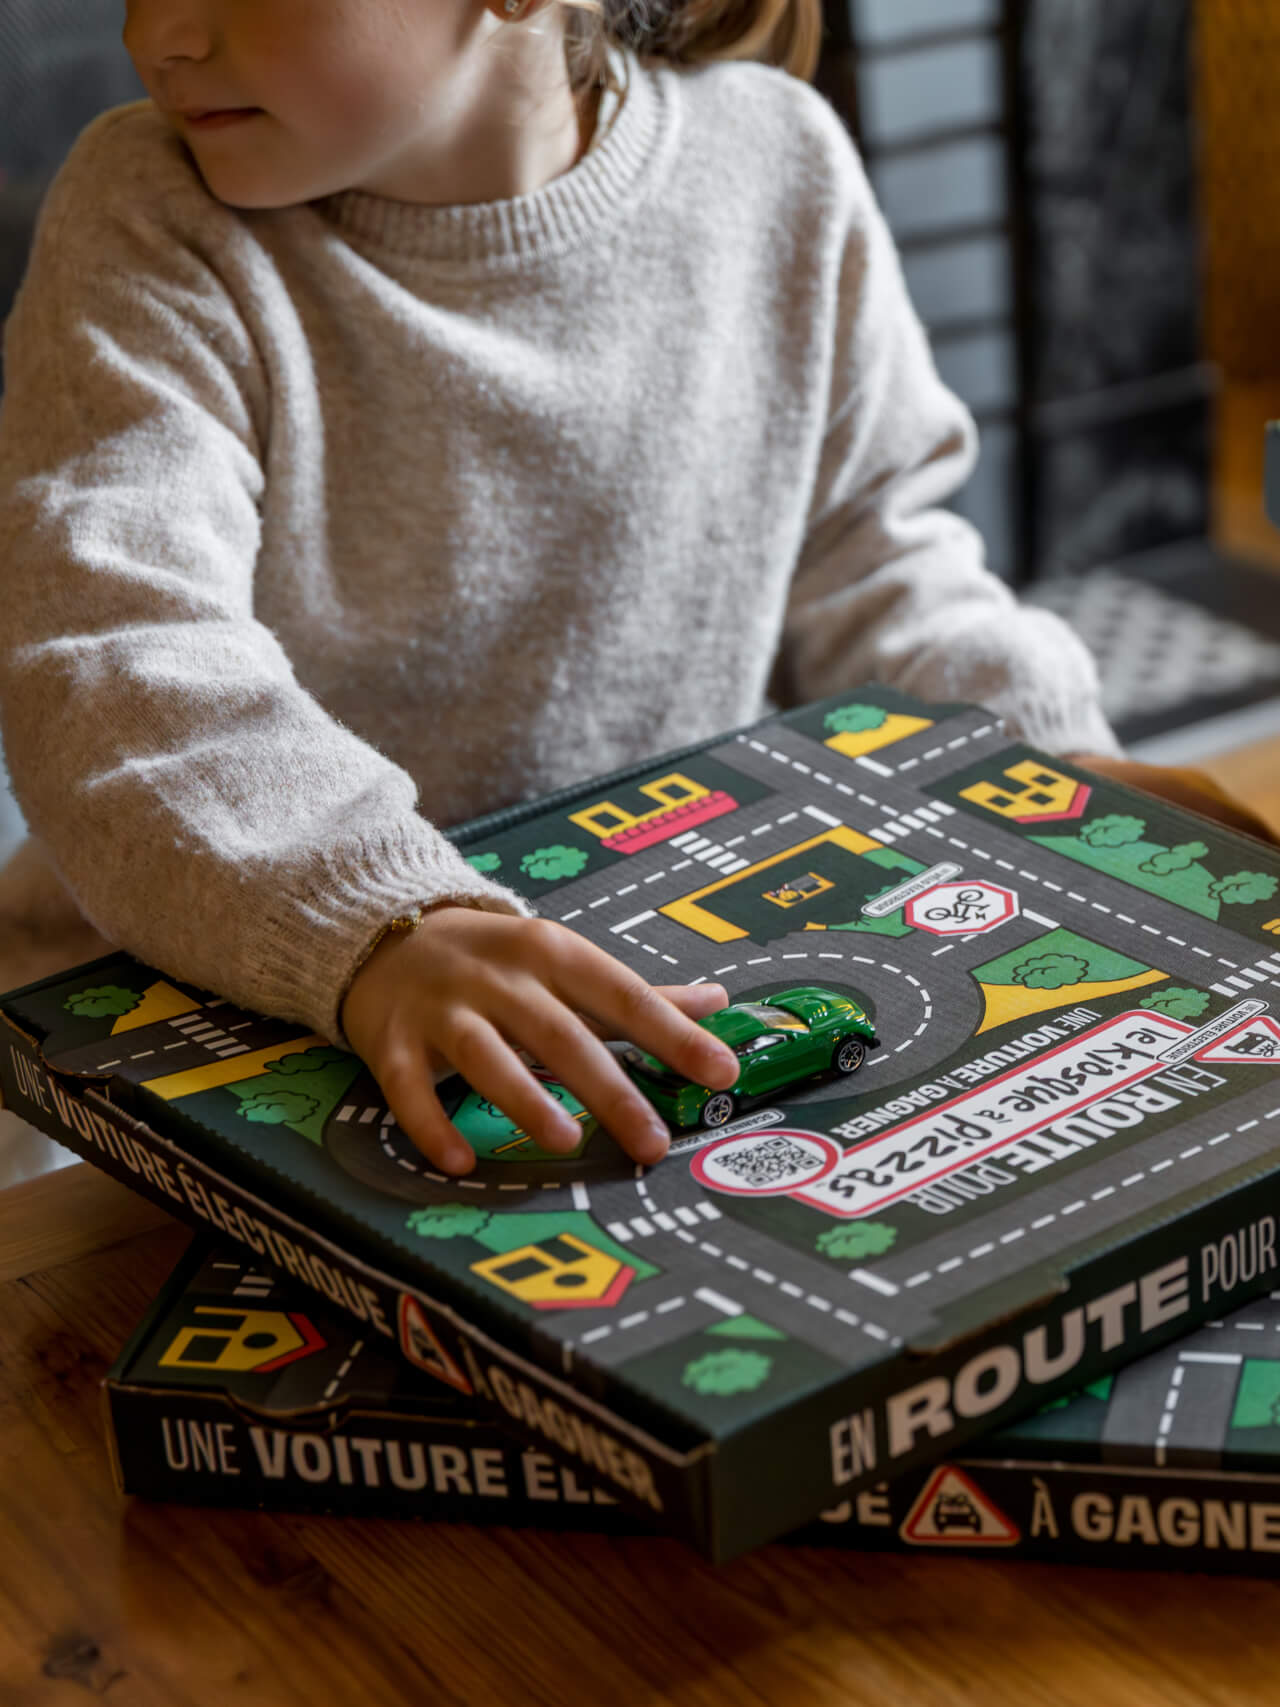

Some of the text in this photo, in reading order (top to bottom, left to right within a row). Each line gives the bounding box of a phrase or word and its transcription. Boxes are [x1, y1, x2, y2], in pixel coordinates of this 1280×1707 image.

[829, 1007, 1102, 1139] UNE VOITURE À GAGNER
[1214, 1010, 1249, 1033] VOITURE
[829, 1028, 1178, 1199] le kiosque à pizzas
[905, 1063, 1228, 1215] EN ROUTE POUR
[10, 1044, 52, 1115] UNE
[47, 1074, 185, 1204] VOITURE
[176, 1161, 395, 1340] ÉLECTRIQUE
[487, 1364, 664, 1513] GAGNER
[830, 1408, 875, 1487] EN
[886, 1256, 1190, 1459] ROUTE
[1202, 1216, 1277, 1303] POUR
[160, 1417, 240, 1475] UNE
[248, 1426, 509, 1498] VOITURE
[522, 1445, 620, 1505] ÉL
[1030, 1475, 1060, 1539] À
